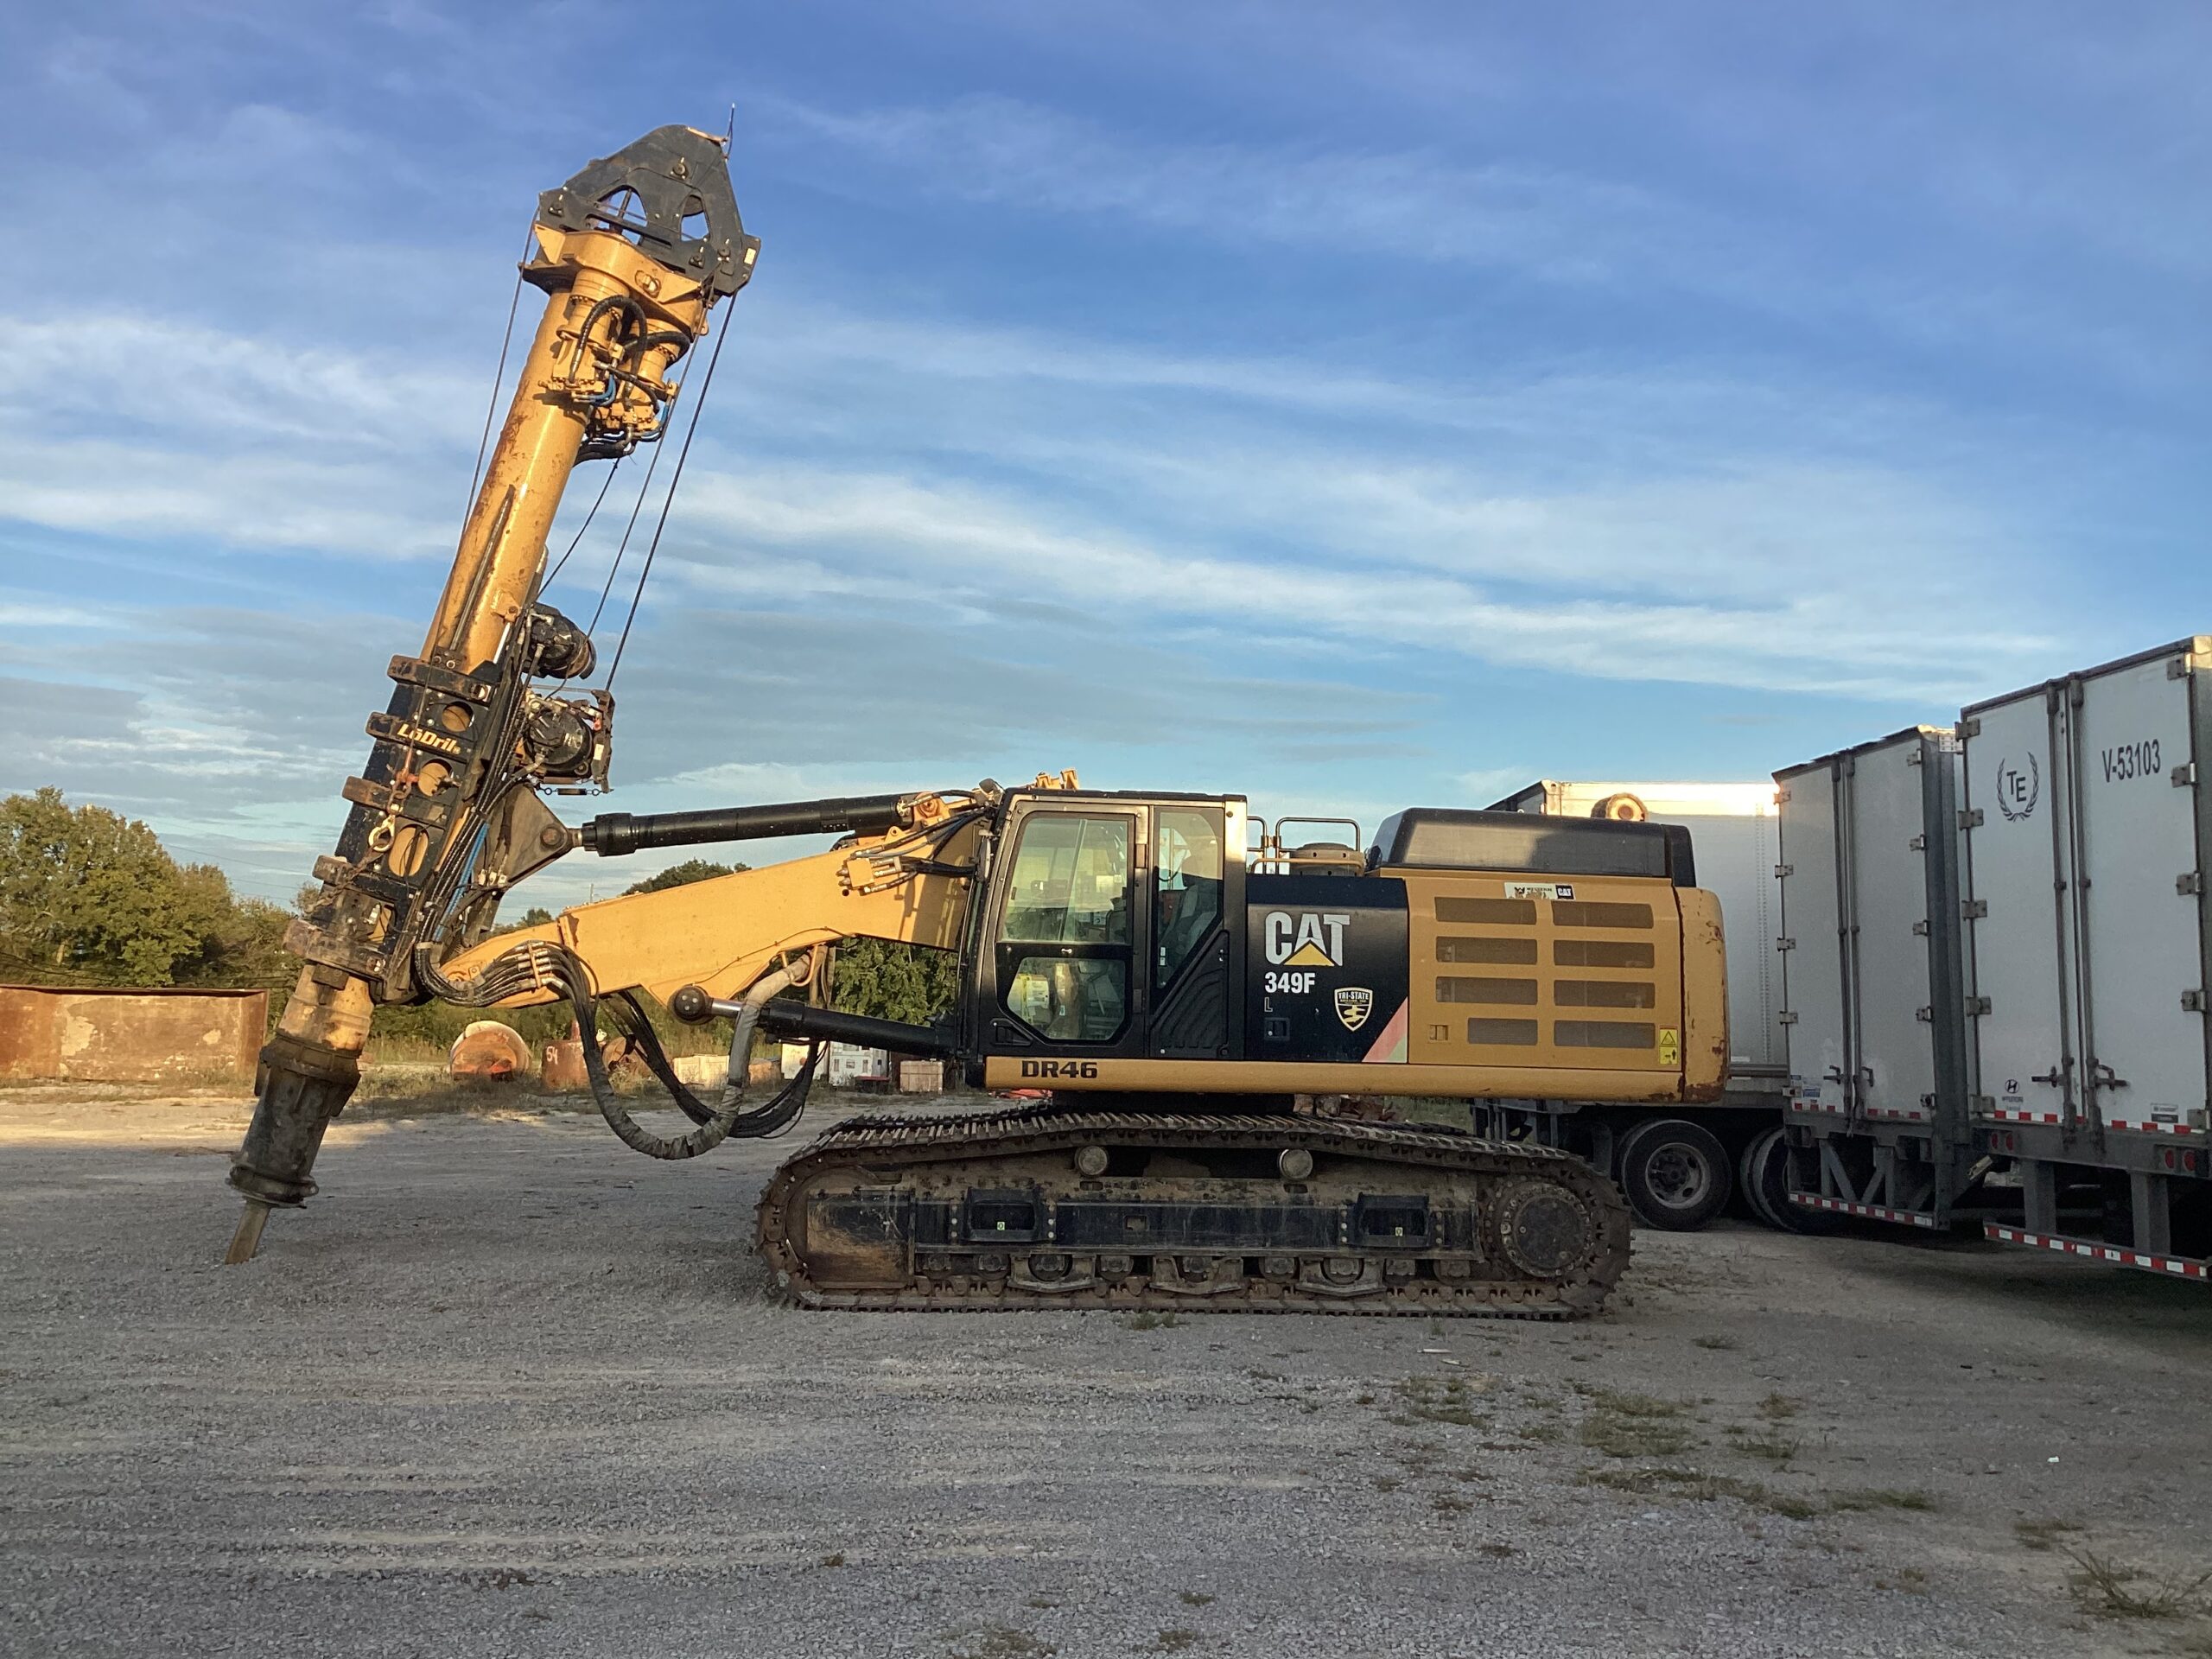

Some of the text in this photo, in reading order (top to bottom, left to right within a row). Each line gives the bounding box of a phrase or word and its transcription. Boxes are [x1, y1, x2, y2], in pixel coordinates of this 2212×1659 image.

[2102, 739, 2161, 783] V-53103
[1557, 887, 1572, 897] CAT
[1265, 912, 1351, 967] CAT
[1264, 971, 1316, 994] 349F
[1264, 996, 1274, 1013] L
[1338, 991, 1370, 1000] TRI-STATE
[1021, 1060, 1098, 1078] DR46
